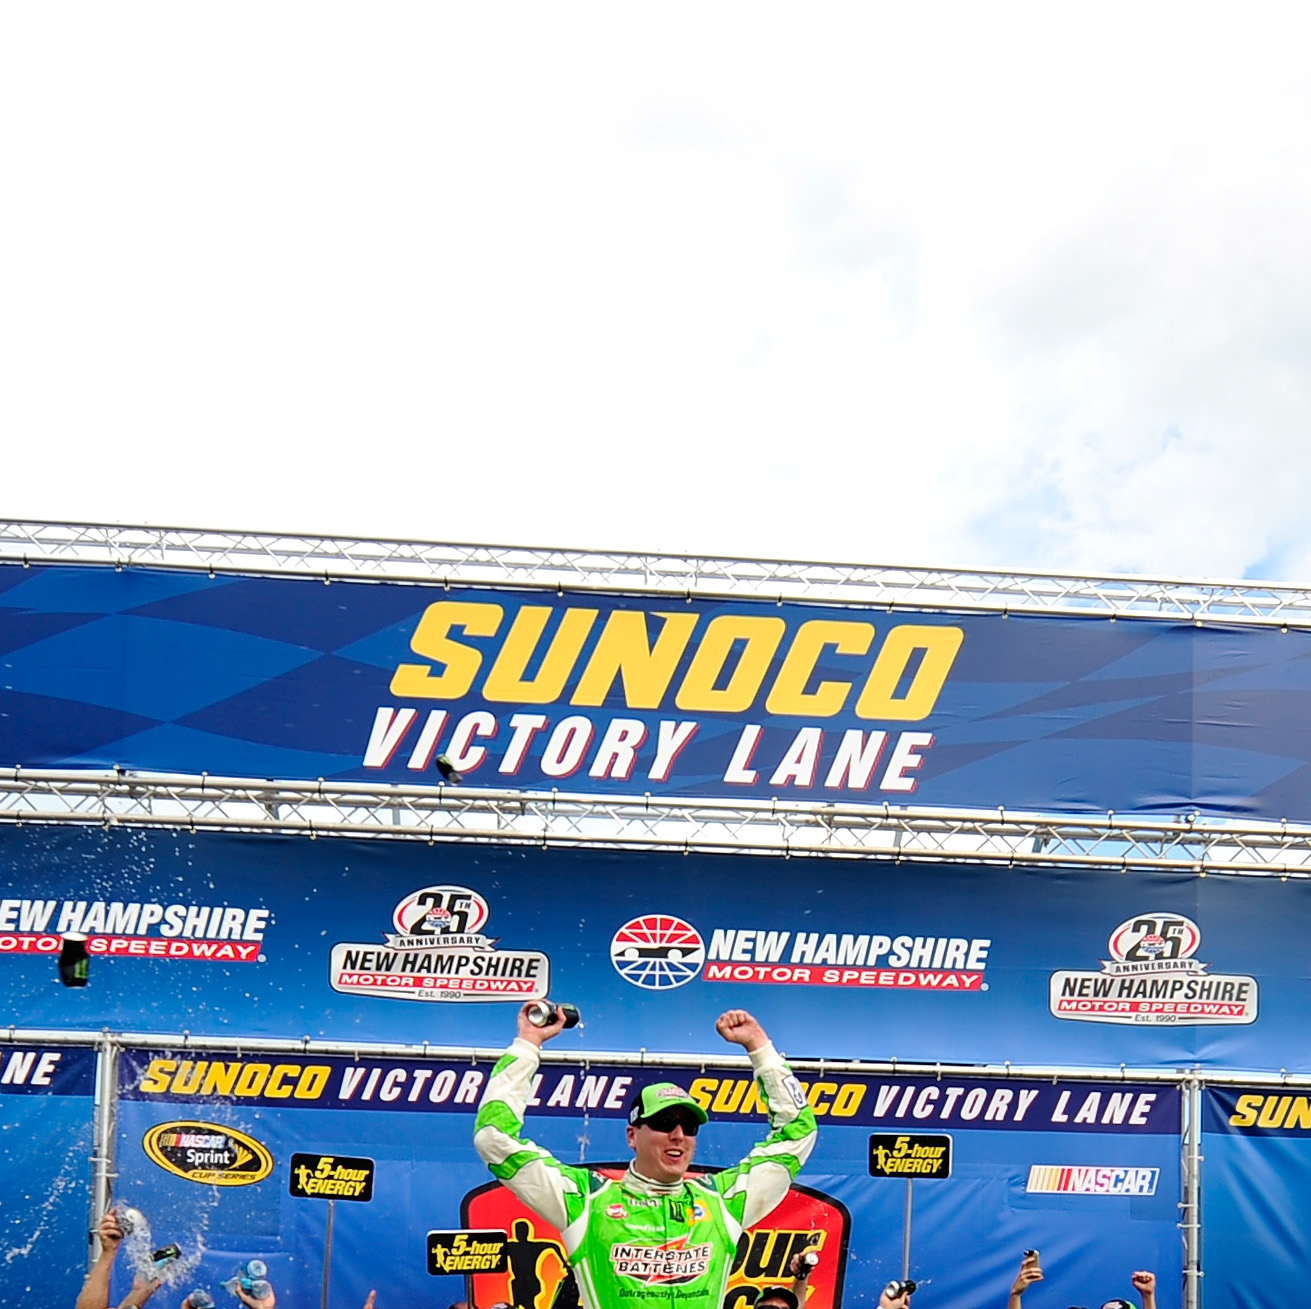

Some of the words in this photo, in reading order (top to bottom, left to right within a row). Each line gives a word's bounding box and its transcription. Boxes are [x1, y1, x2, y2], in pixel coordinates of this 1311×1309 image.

[389, 601, 964, 721] SUNOCO
[363, 707, 699, 781] VICTORY
[724, 725, 935, 792] LANE
[56, 901, 269, 941] HAMPSHIRE
[90, 939, 255, 959] SPEEDWAY
[398, 935, 481, 950] ANNIVERSARY
[710, 929, 792, 960] NEW
[793, 932, 990, 970] HAMPSHIRE
[343, 952, 398, 973] NEW
[401, 954, 539, 979] HAMPSHIRE
[1115, 959, 1196, 975] ANNIVERSARY
[339, 974, 418, 988] MOTOR
[424, 977, 534, 993] SPEEDWAY
[707, 965, 810, 983] MOTOR
[823, 969, 981, 990] SPEEDWAY
[416, 990, 437, 999] Est.
[440, 991, 461, 999] 1990
[1061, 976, 1113, 1000] NEW
[1116, 978, 1249, 1004] HAMPSHIRE
[1060, 1000, 1132, 1013] MOTOR
[1138, 1002, 1244, 1016] SPEEDWAY
[1135, 1013, 1152, 1022] Est.
[1156, 1013, 1176, 1023] 1990
[139, 1060, 331, 1099] SUNOCO
[339, 1066, 485, 1104] VICTOR
[524, 1074, 632, 1109] LANE
[873, 1085, 1040, 1123] VICTORY
[1051, 1090, 1157, 1126] LANE
[893, 1136, 945, 1157] 5-hour
[187, 1150, 231, 1166] Sprint
[886, 1155, 941, 1174] ENERGY
[191, 1171, 215, 1179] CUP
[218, 1172, 257, 1180] SERIES
[315, 1158, 369, 1182] 5-hour
[309, 1180, 364, 1196] ENERGY
[1069, 1168, 1155, 1194] NASCAR
[451, 1235, 504, 1255] 5-hour
[613, 1245, 710, 1261] INTERSTATE
[446, 1254, 501, 1271] ENERGY
